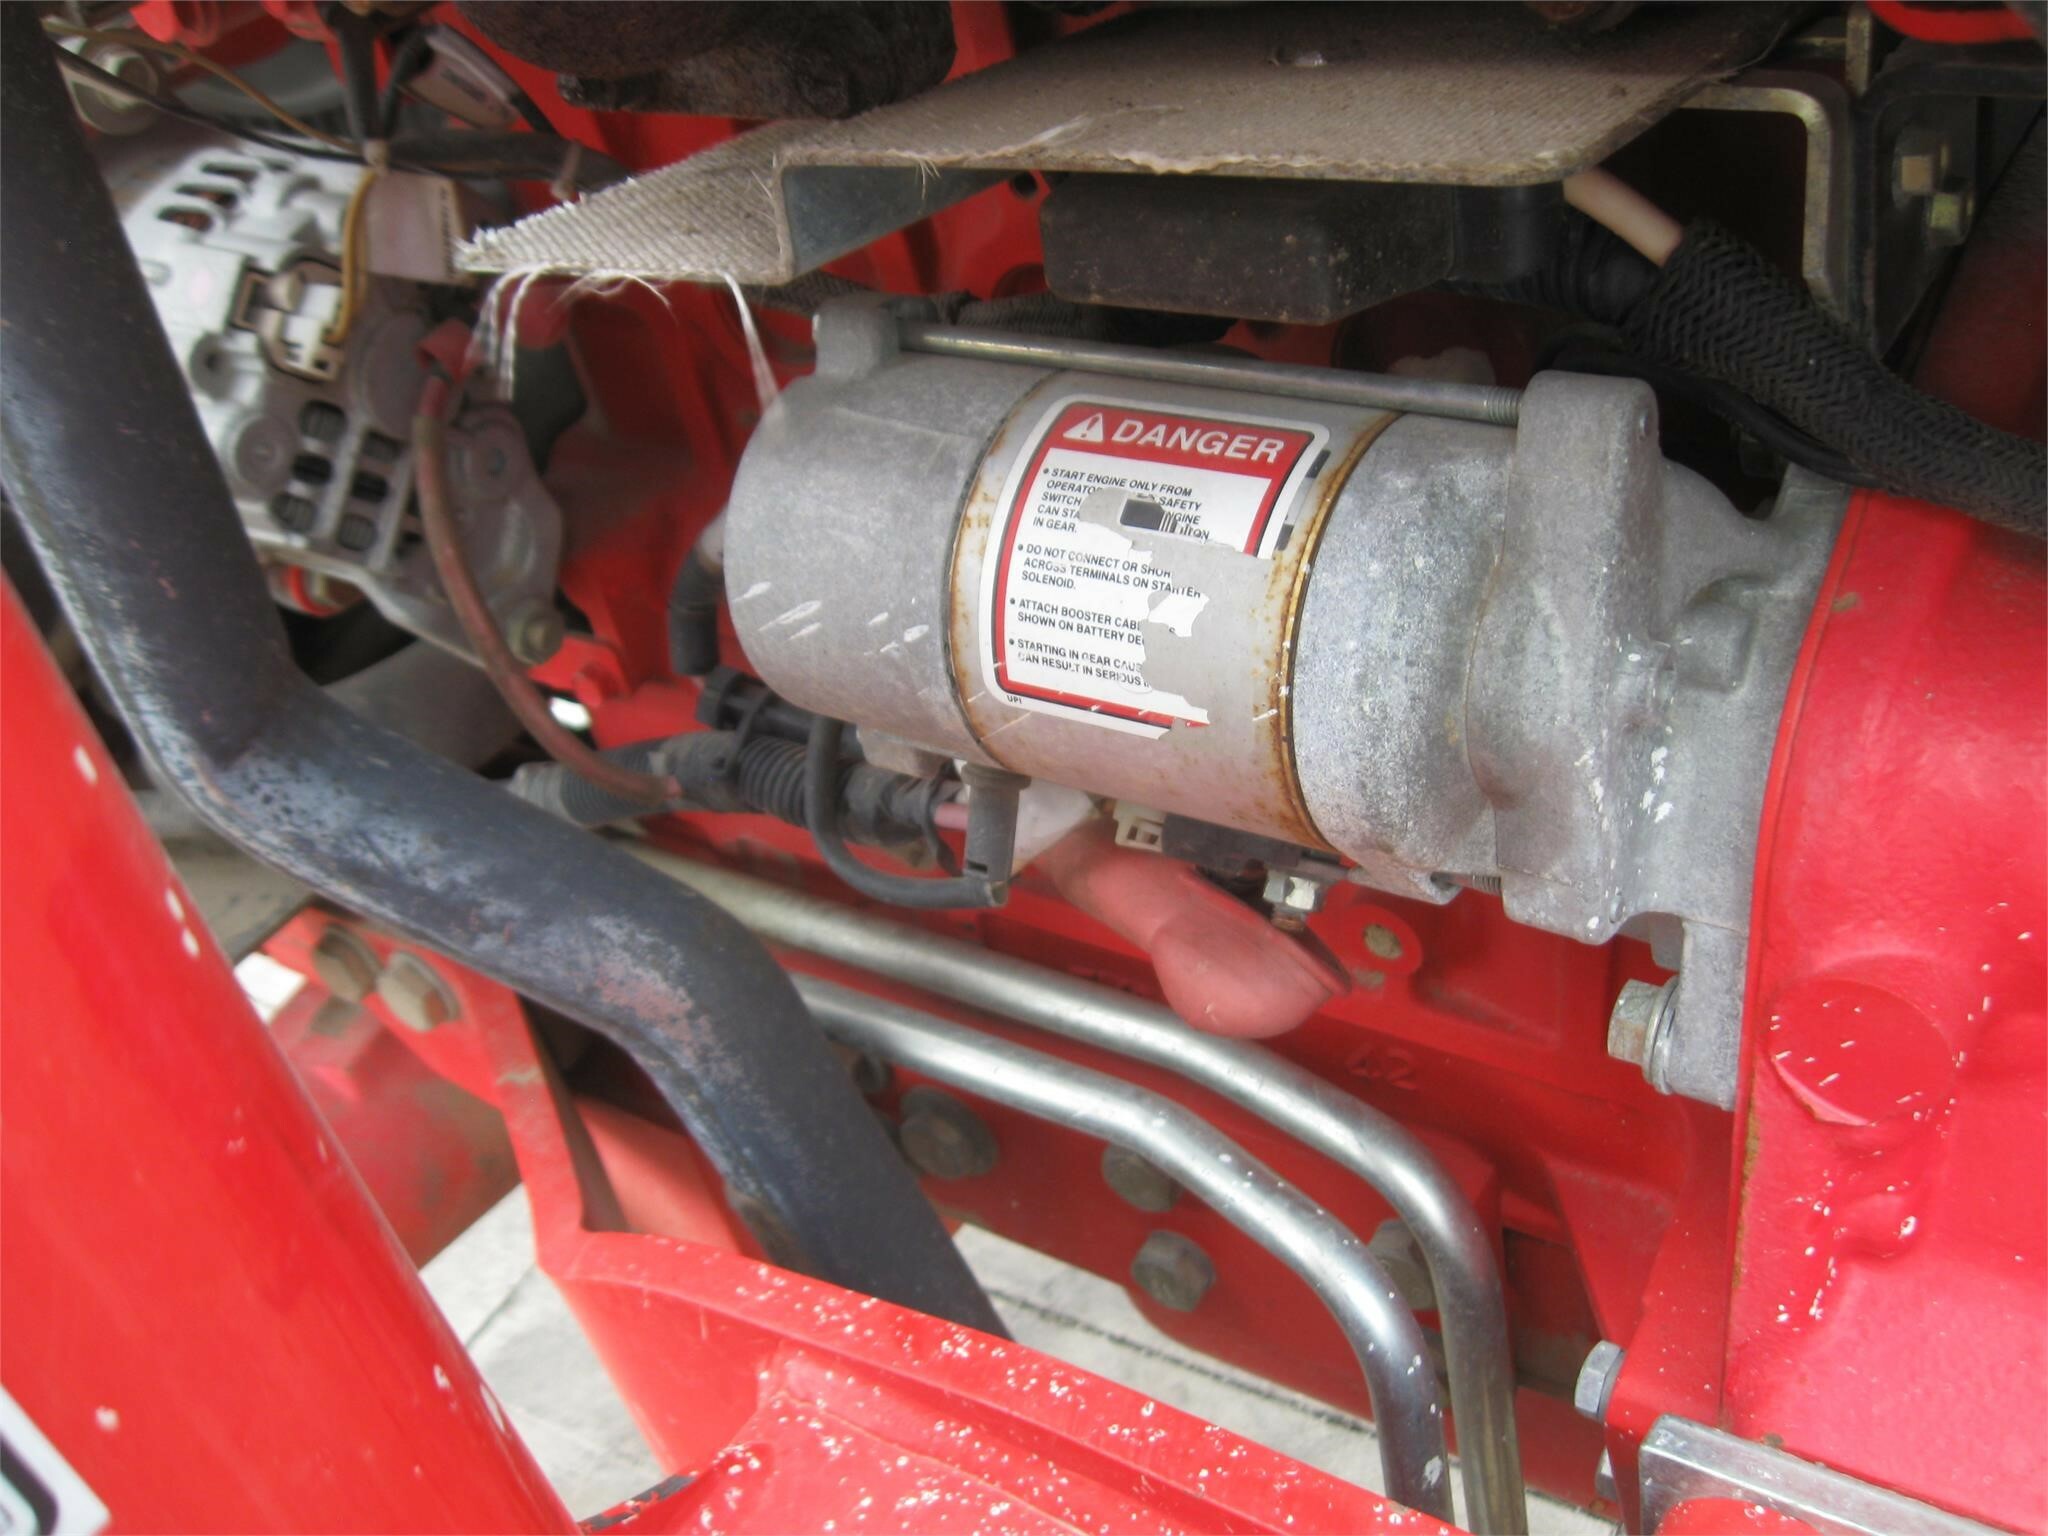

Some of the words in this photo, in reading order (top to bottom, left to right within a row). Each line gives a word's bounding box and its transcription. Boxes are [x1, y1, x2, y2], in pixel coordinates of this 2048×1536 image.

[1111, 418, 1285, 464] DANGER
[1046, 479, 1103, 495] OPERATO
[1159, 496, 1202, 511] SAFETY
[1051, 468, 1085, 481] START
[1087, 473, 1126, 488] ENGINE
[1129, 479, 1157, 491] ONLY
[1159, 484, 1192, 497] FROM
[1037, 504, 1060, 516] CAN
[1041, 491, 1082, 506] SWITCH
[1033, 516, 1044, 527] IN
[1046, 518, 1077, 533] GEAR.
[1026, 543, 1042, 555] DO
[1044, 546, 1066, 559] NOT
[1068, 551, 1120, 569] CONNECT
[1122, 560, 1138, 572] OR
[1021, 570, 1076, 590] SOLENOID.
[1024, 557, 1066, 573] ACROSS
[1070, 564, 1130, 585] TERMINALS
[1133, 576, 1149, 589] ON
[1018, 598, 1058, 615] ATTACH
[1061, 607, 1112, 625] BOOSTER
[1017, 611, 1056, 628] SHOWN
[1058, 619, 1074, 632] ON
[1076, 622, 1124, 642] BATTERY
[1018, 638, 1066, 657] STARTING
[1069, 649, 1079, 660] IN
[1042, 657, 1080, 673] RESULT
[1082, 665, 1093, 676] IN
[1095, 667, 1141, 686] SERIOUS
